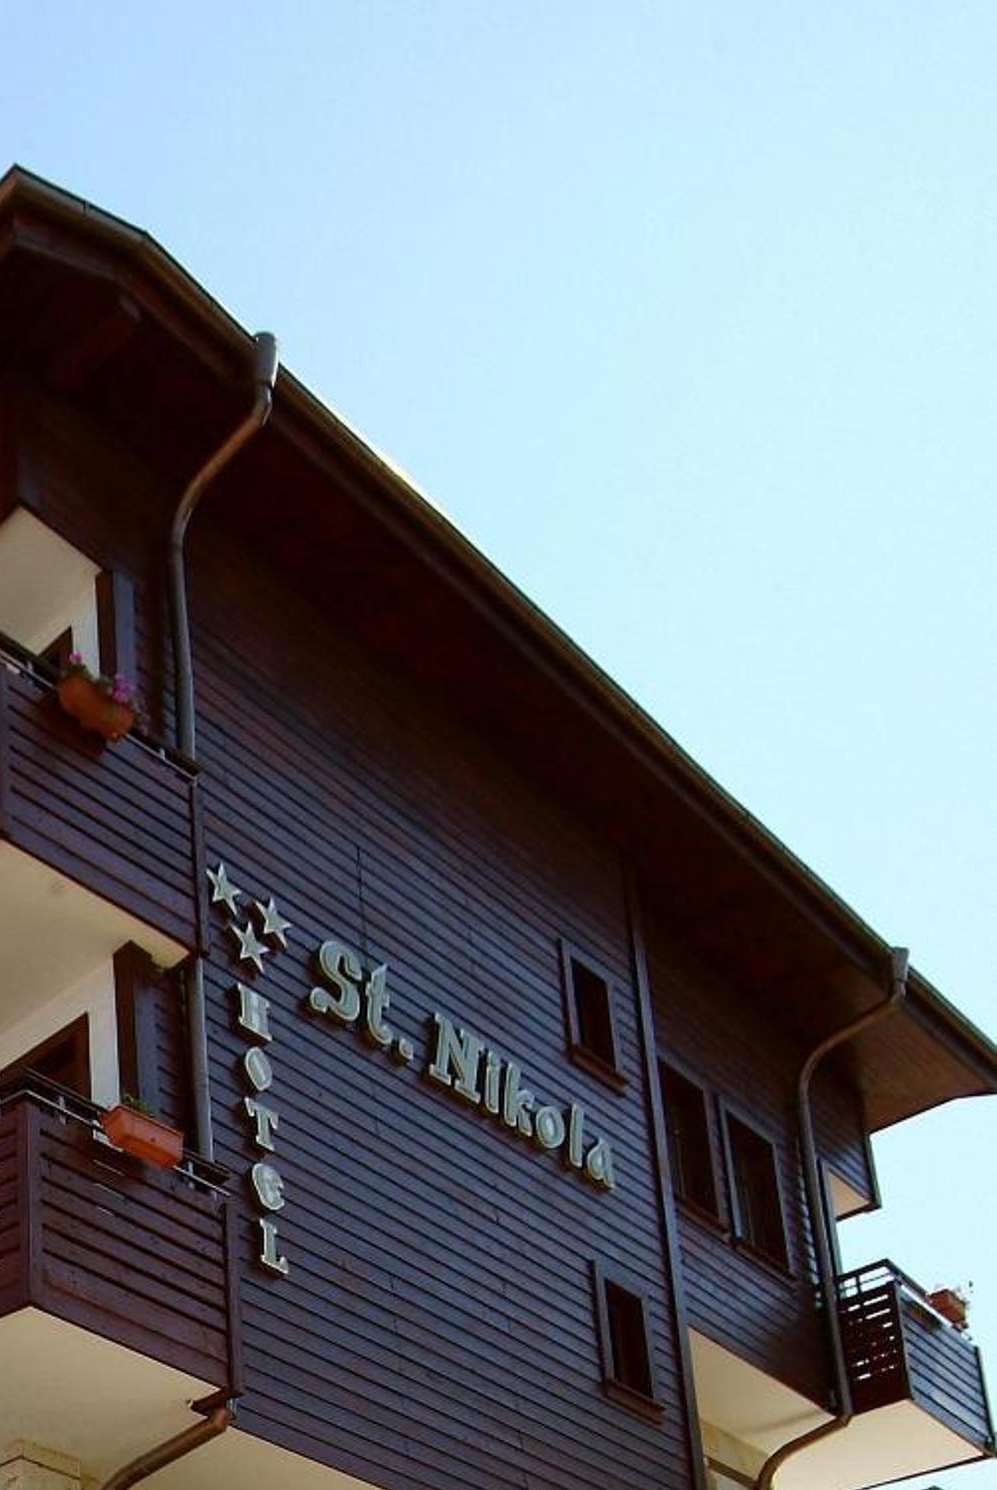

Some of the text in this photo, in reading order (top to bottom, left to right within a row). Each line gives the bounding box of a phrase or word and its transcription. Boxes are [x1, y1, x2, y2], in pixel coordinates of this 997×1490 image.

[235, 981, 290, 1276] HOTEL
[309, 939, 617, 1191] St. Nikola
